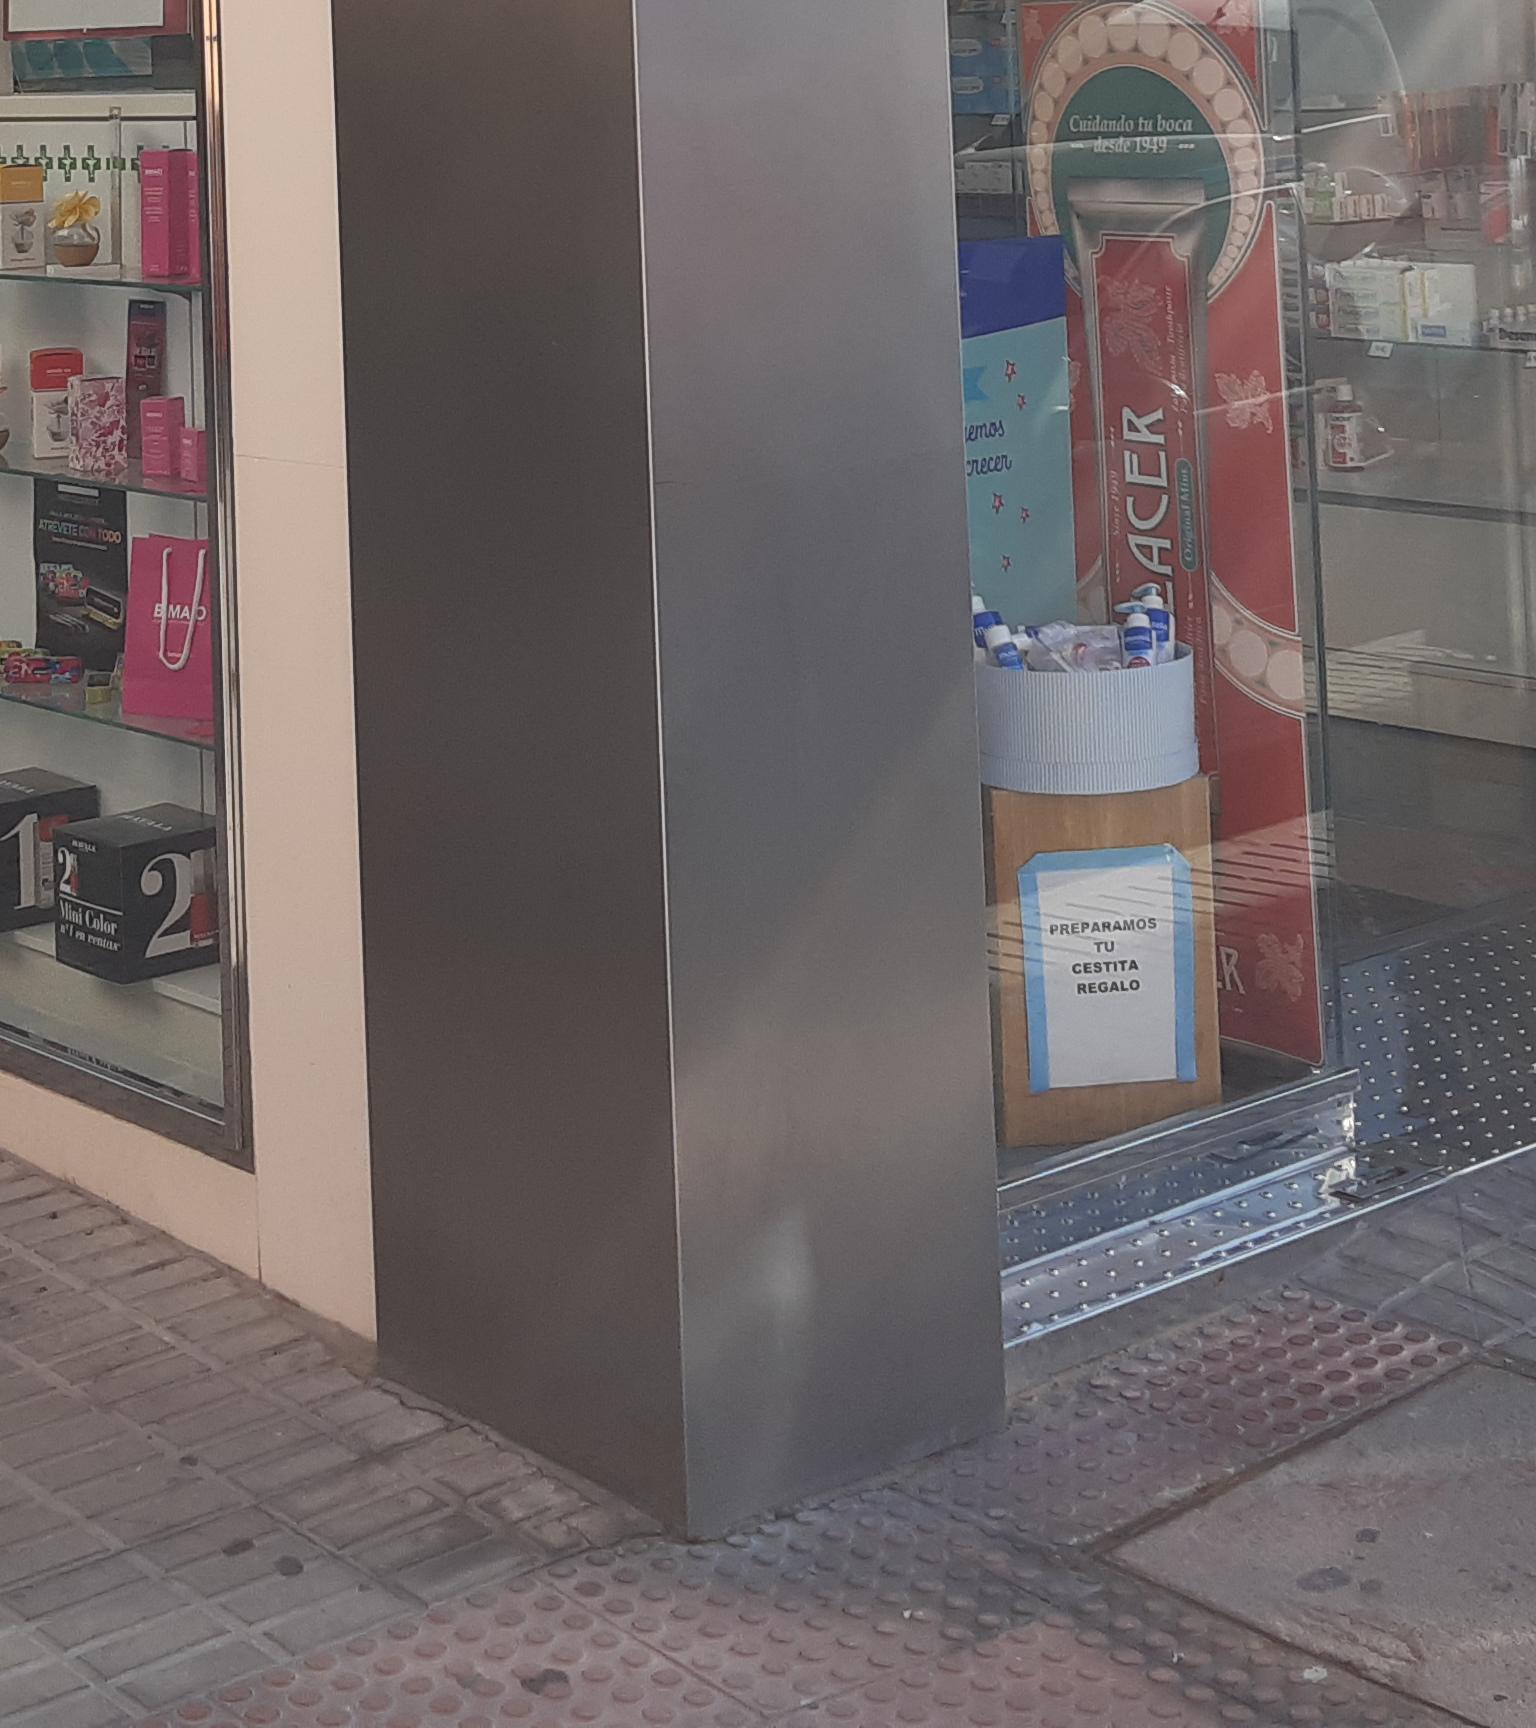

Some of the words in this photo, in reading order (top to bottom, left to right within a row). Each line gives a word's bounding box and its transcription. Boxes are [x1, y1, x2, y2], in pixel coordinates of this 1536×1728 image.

[1069, 114, 1135, 133] Cuidando
[1138, 115, 1153, 132] tu
[1156, 113, 1193, 133] boca
[1093, 135, 1131, 153] desde
[1135, 135, 1168, 154] 1949
[964, 419, 1006, 443] emos
[1179, 469, 1190, 506] Mint
[97, 527, 122, 544] TODO
[1182, 508, 1194, 561] Original
[153, 603, 207, 621] BMAO
[140, 852, 192, 959] 2
[85, 908, 119, 936] Color
[1049, 917, 1158, 936] PREPARAMOS
[75, 931, 86, 942] en
[87, 932, 121, 952] ventas
[1093, 940, 1115, 953] TU
[1071, 959, 1140, 975] CESTITA
[1076, 979, 1141, 995] REGALO
